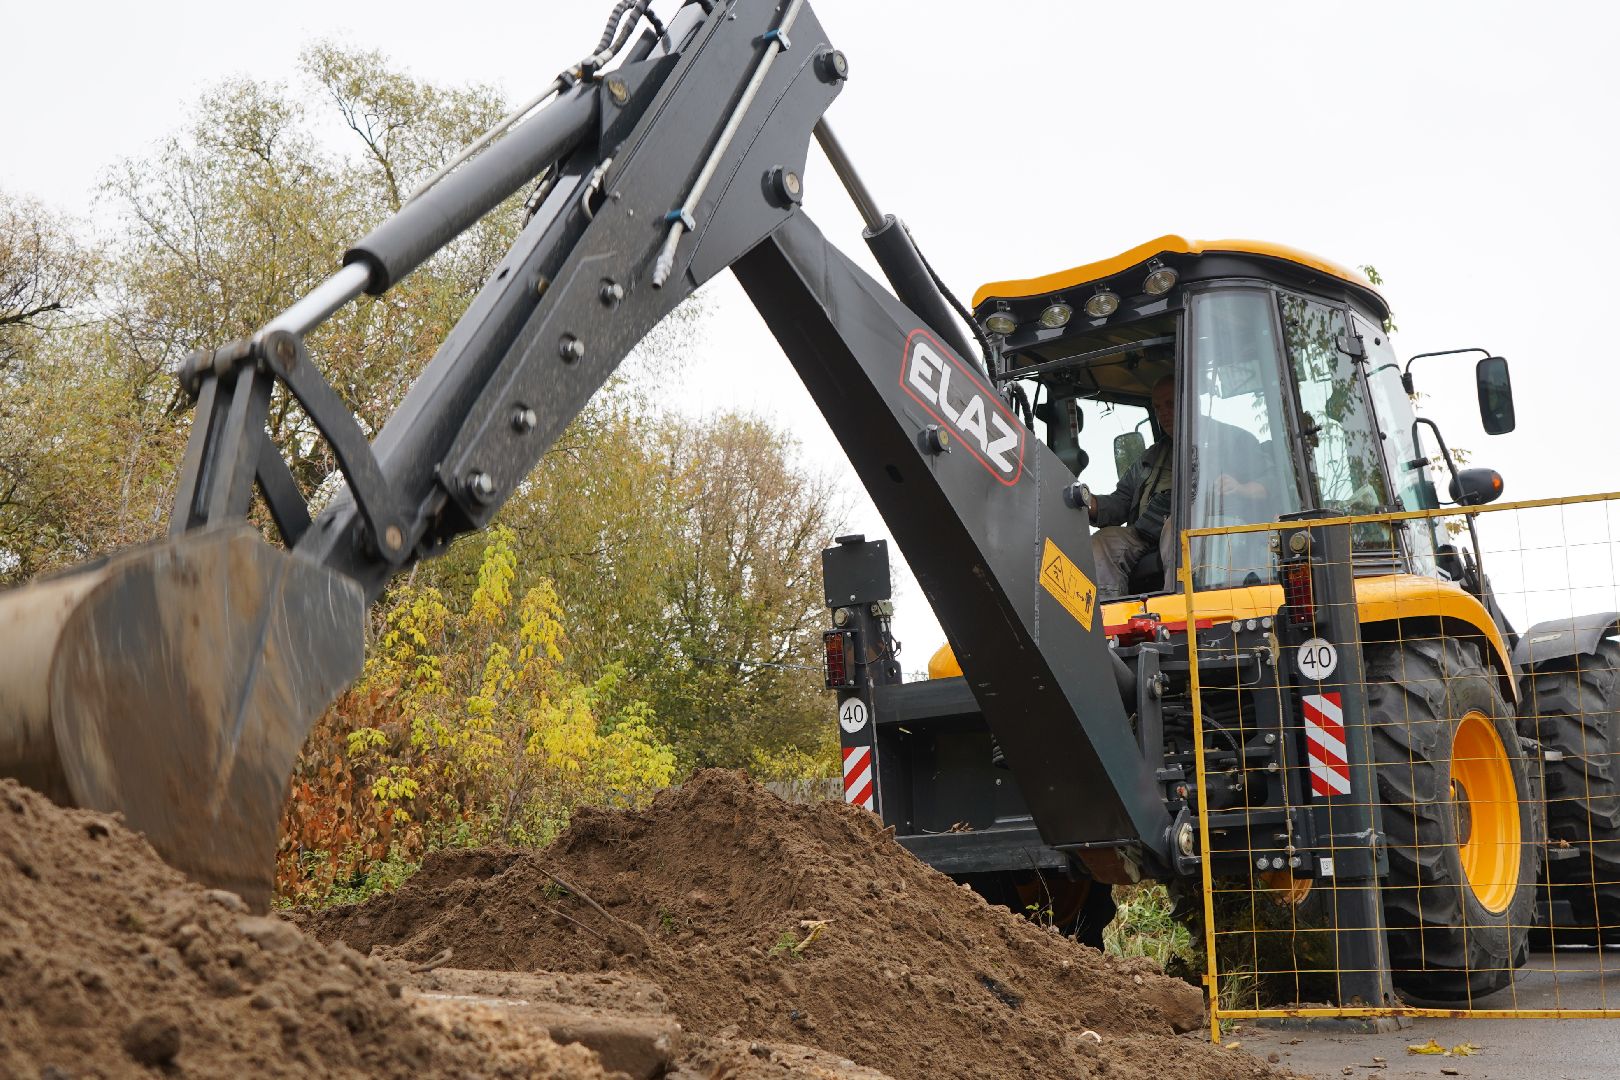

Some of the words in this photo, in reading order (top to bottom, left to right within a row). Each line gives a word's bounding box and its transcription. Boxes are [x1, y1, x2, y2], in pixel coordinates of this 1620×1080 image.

[908, 342, 1018, 473] ELAZ
[1302, 646, 1332, 669] 40
[843, 704, 864, 724] 40
